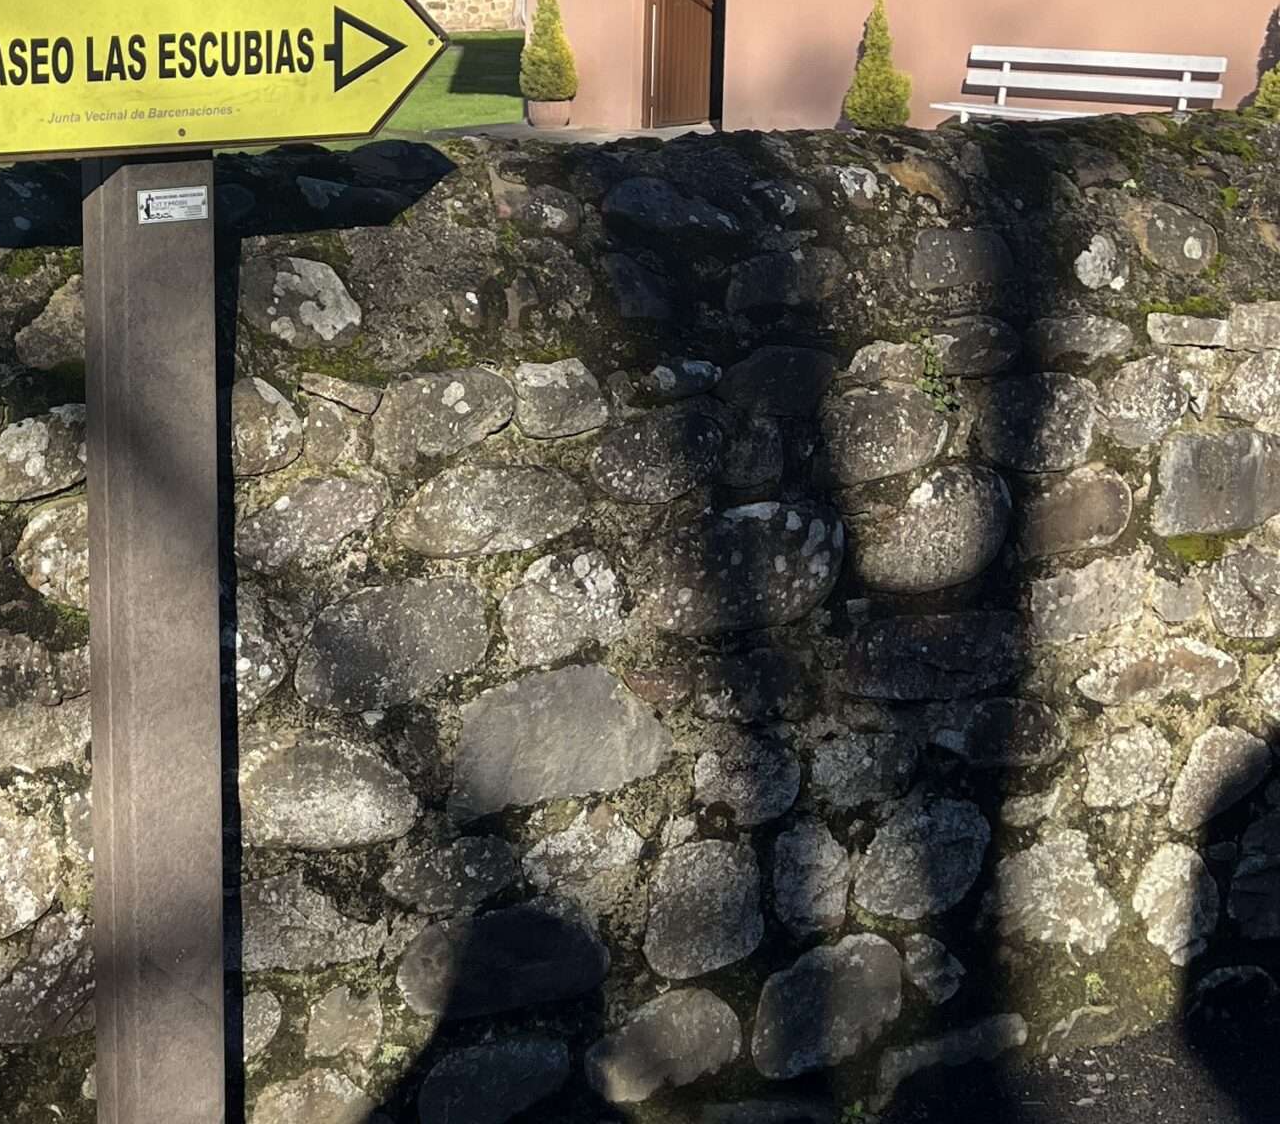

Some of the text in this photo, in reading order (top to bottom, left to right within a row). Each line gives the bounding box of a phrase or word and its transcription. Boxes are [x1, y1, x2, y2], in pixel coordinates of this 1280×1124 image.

[86, 32, 147, 82] LAS
[158, 27, 315, 80] ESCUBIAS
[48, 112, 81, 125] Junta
[85, 109, 128, 123] Vecinal
[130, 108, 145, 120] de
[148, 106, 233, 119] Barcenaciones
